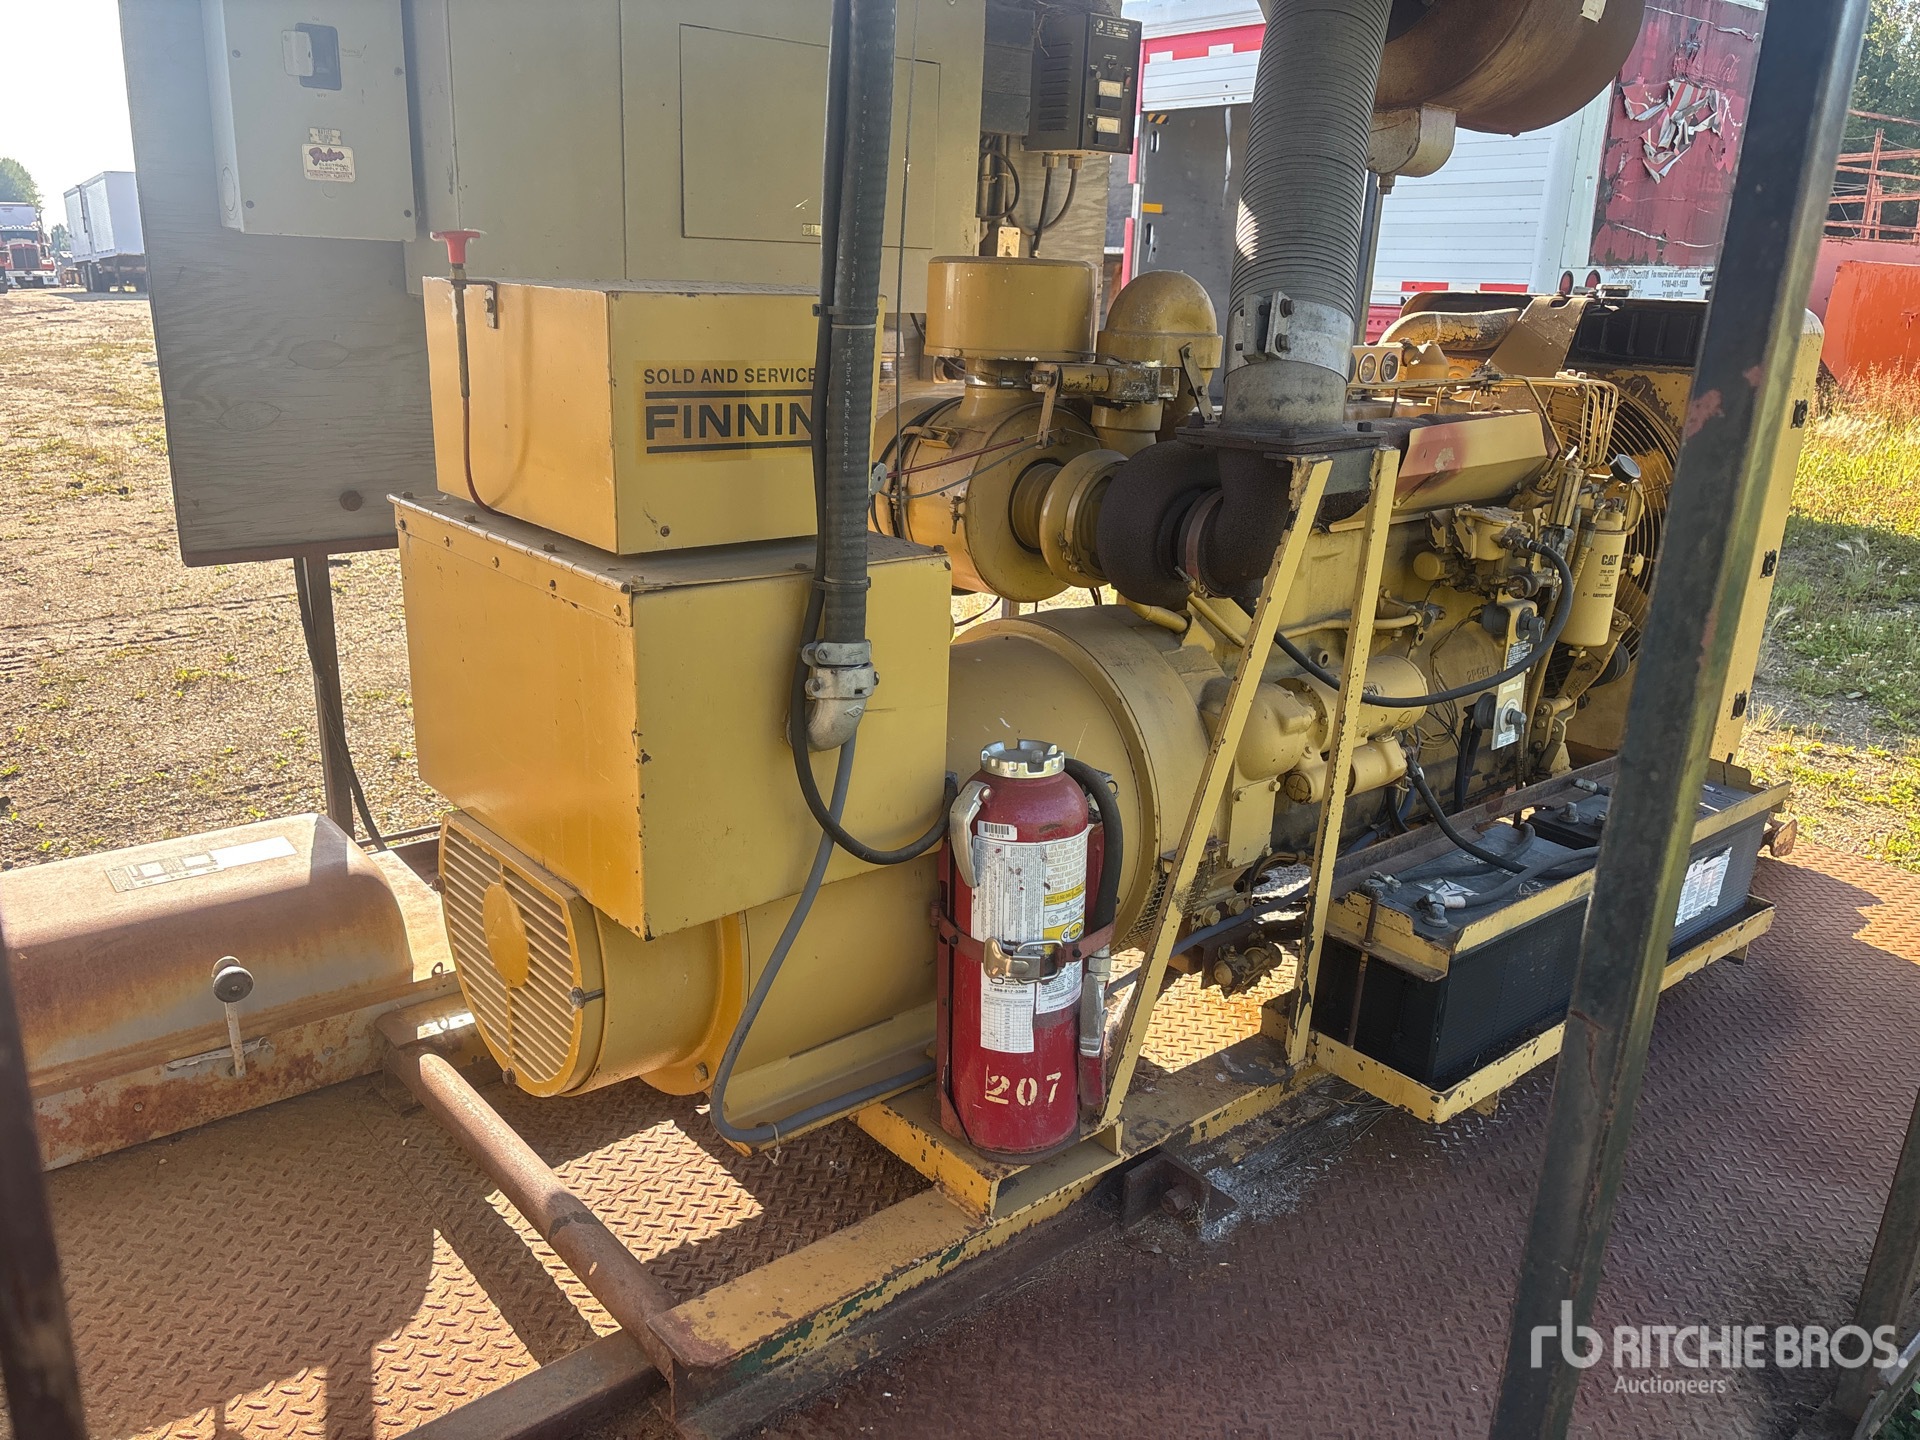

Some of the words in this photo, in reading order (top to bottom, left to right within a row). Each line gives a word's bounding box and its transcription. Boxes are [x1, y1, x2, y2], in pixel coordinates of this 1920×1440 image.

[644, 368, 695, 385] SOLD
[700, 368, 739, 384] AND
[744, 367, 816, 384] SERVICE
[646, 403, 812, 440] FINNIN
[1601, 554, 1619, 566] CAT
[985, 1069, 1062, 1107] 207
